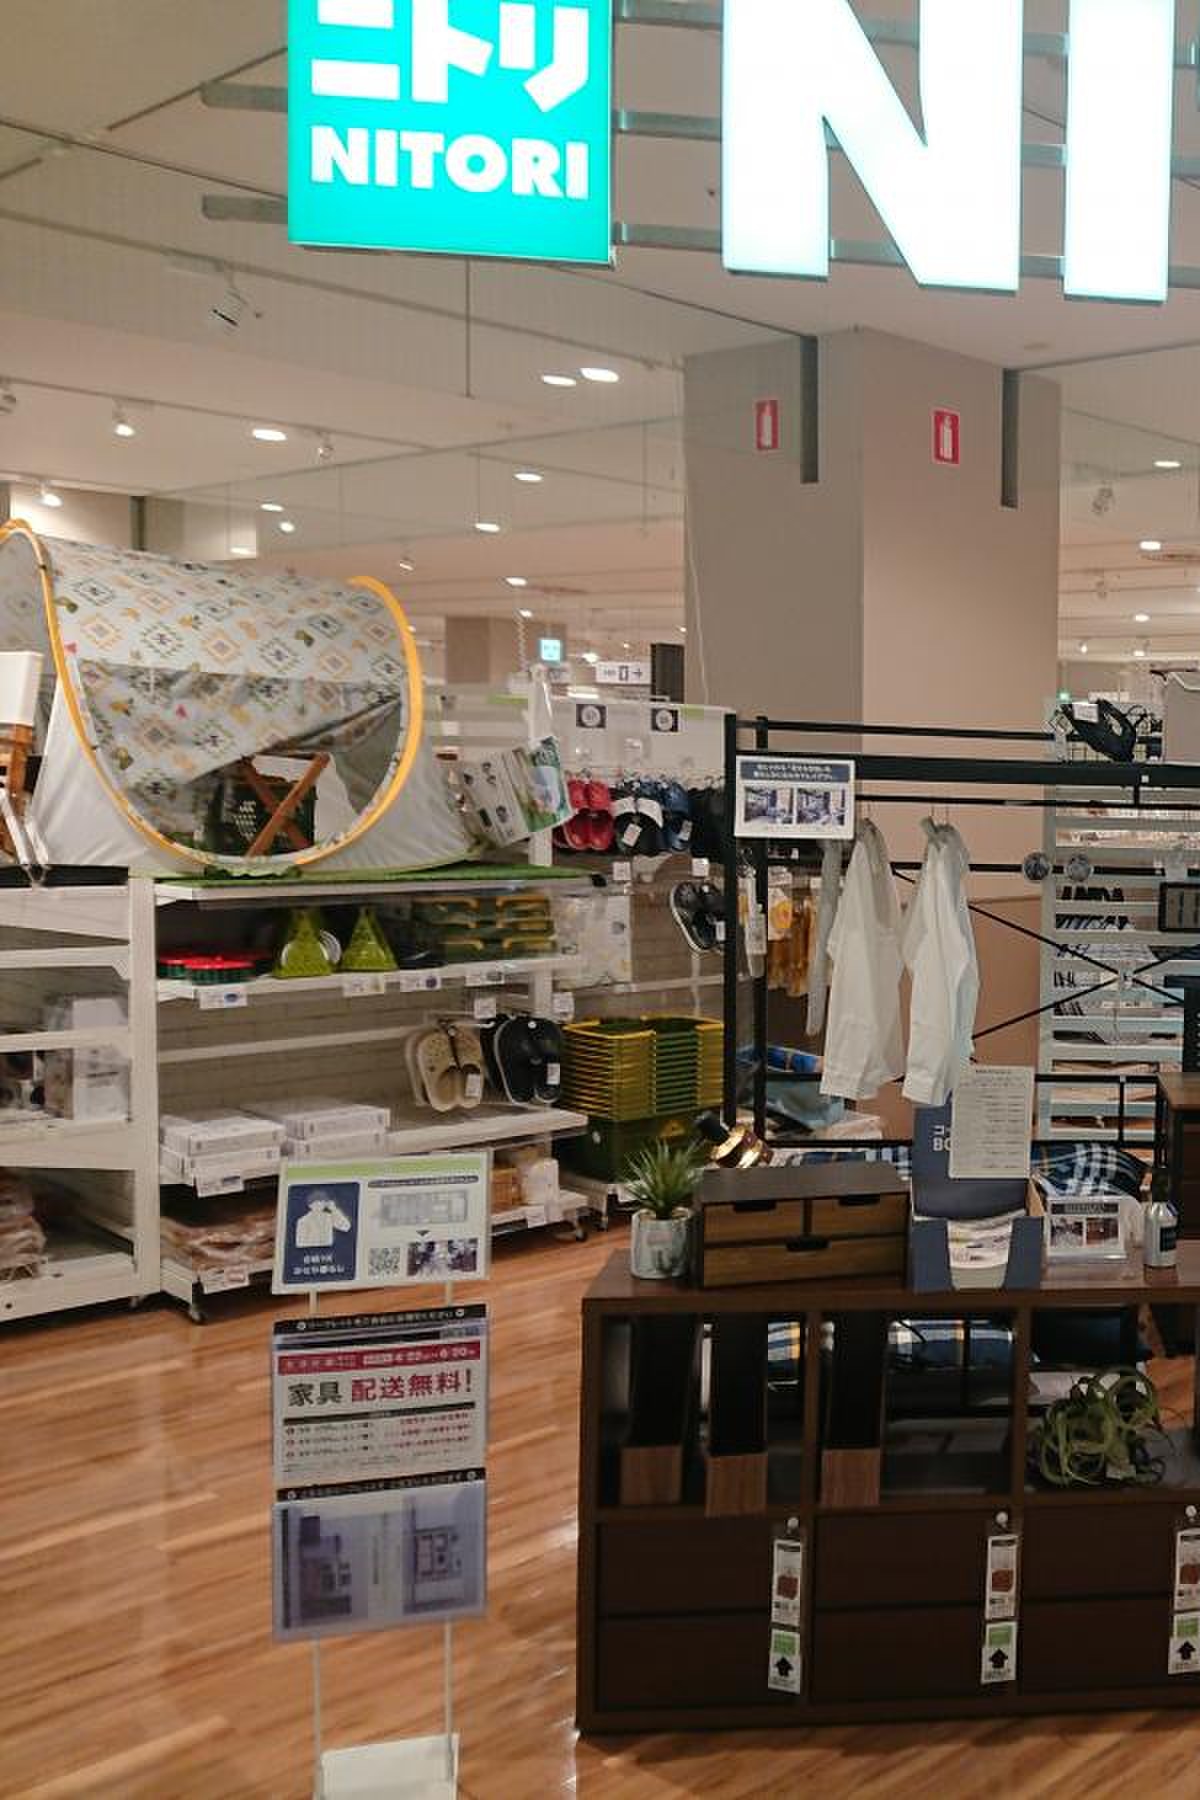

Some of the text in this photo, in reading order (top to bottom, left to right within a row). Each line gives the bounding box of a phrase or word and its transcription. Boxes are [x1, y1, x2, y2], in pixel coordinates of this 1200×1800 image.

[311, 0, 589, 112] ニトリ
[311, 124, 589, 201] NITORI
[288, 1368, 471, 1407] 家具 配送無料!
